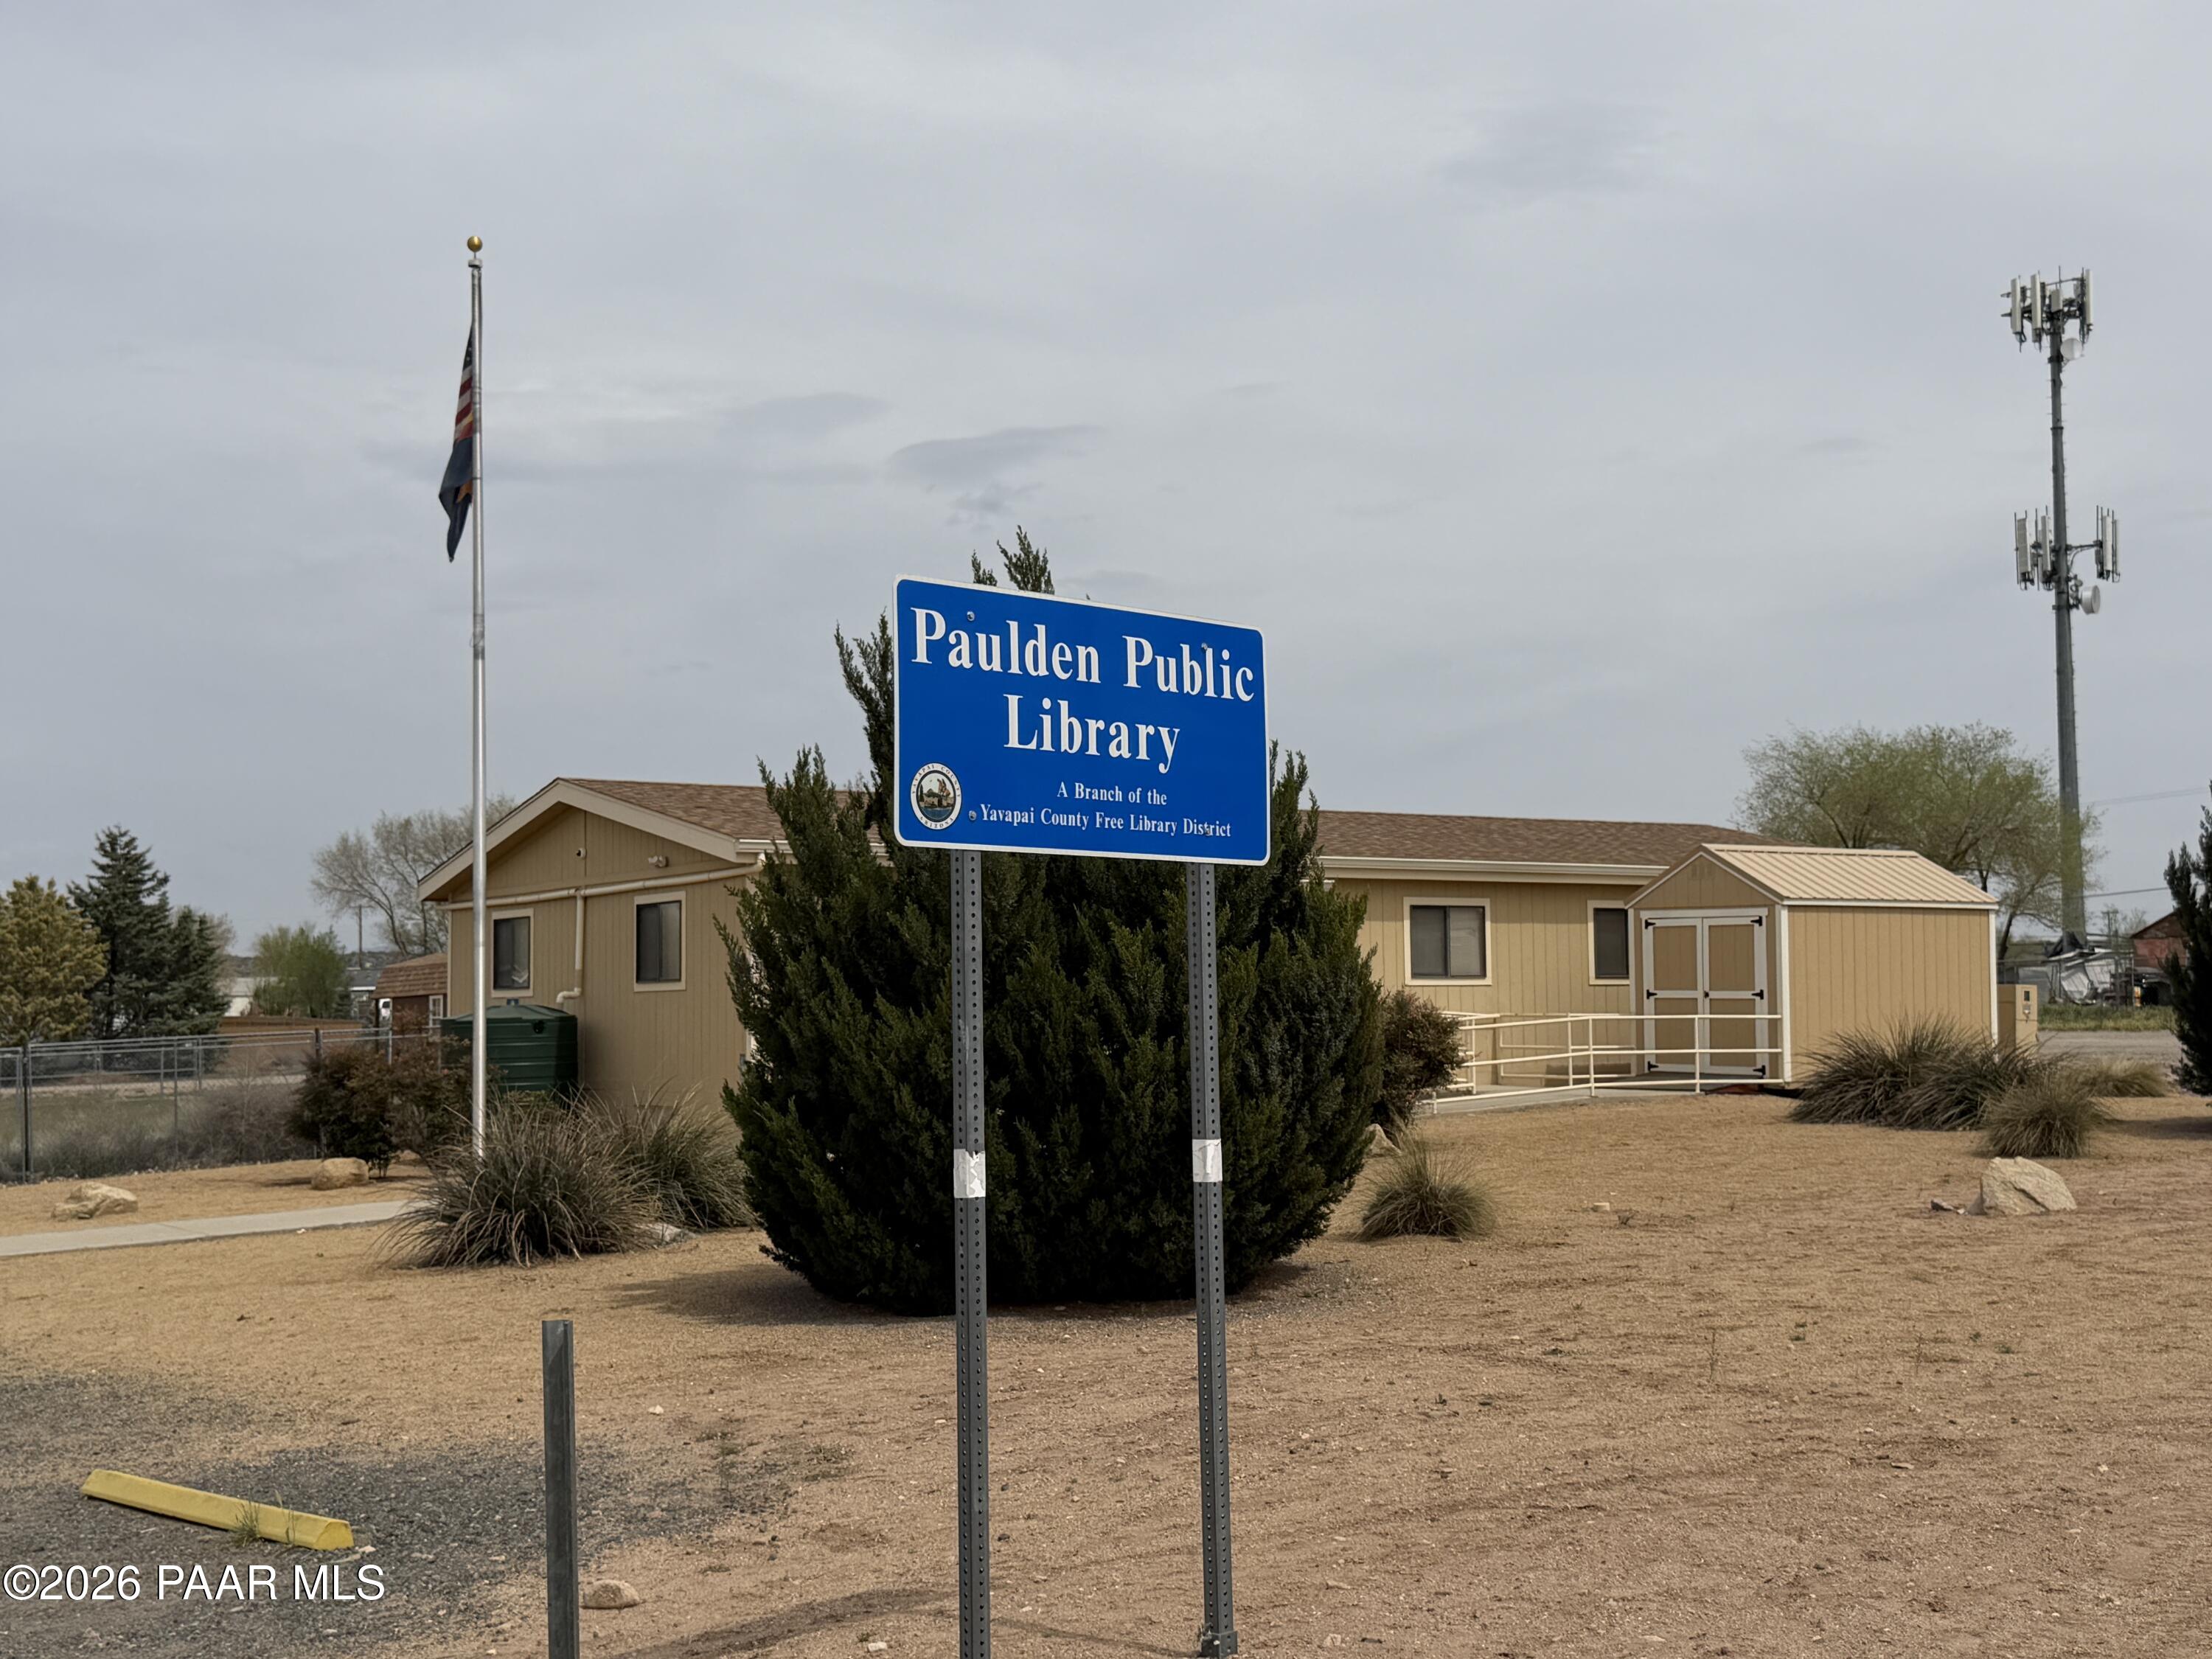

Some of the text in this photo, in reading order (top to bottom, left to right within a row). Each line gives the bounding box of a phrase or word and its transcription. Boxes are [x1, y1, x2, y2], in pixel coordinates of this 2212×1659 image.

[911, 606, 1255, 703] Paulden Public
[1003, 693, 1180, 774] Library
[980, 804, 1231, 837] Yavapai County Free Library District
[1057, 782, 1168, 805] A Branch of the
